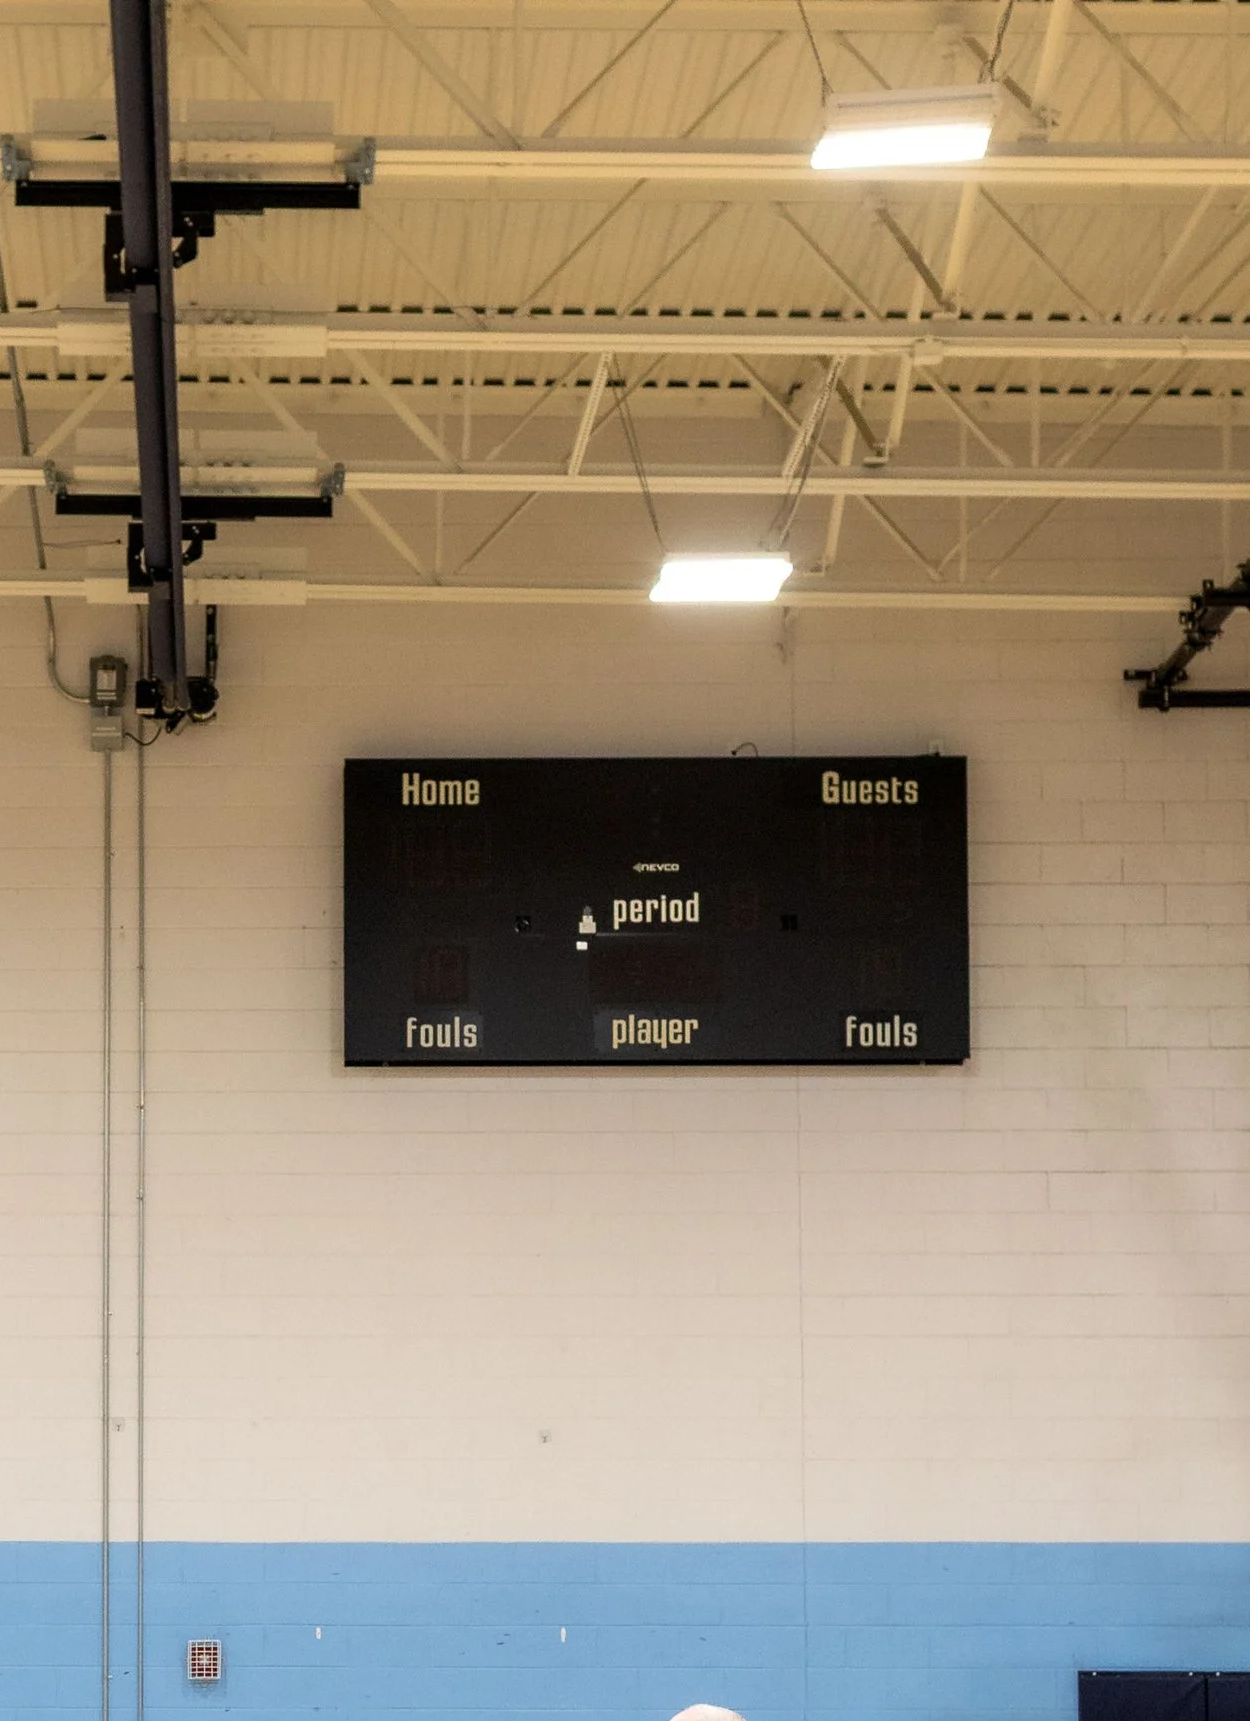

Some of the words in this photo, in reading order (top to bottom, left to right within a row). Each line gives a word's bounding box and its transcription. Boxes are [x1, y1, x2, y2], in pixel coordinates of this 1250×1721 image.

[402, 773, 480, 805] Home
[822, 771, 919, 804] Guests
[613, 891, 700, 931] period
[406, 1015, 478, 1048] fouls
[612, 1013, 699, 1050] player
[845, 1014, 918, 1047] fouls
